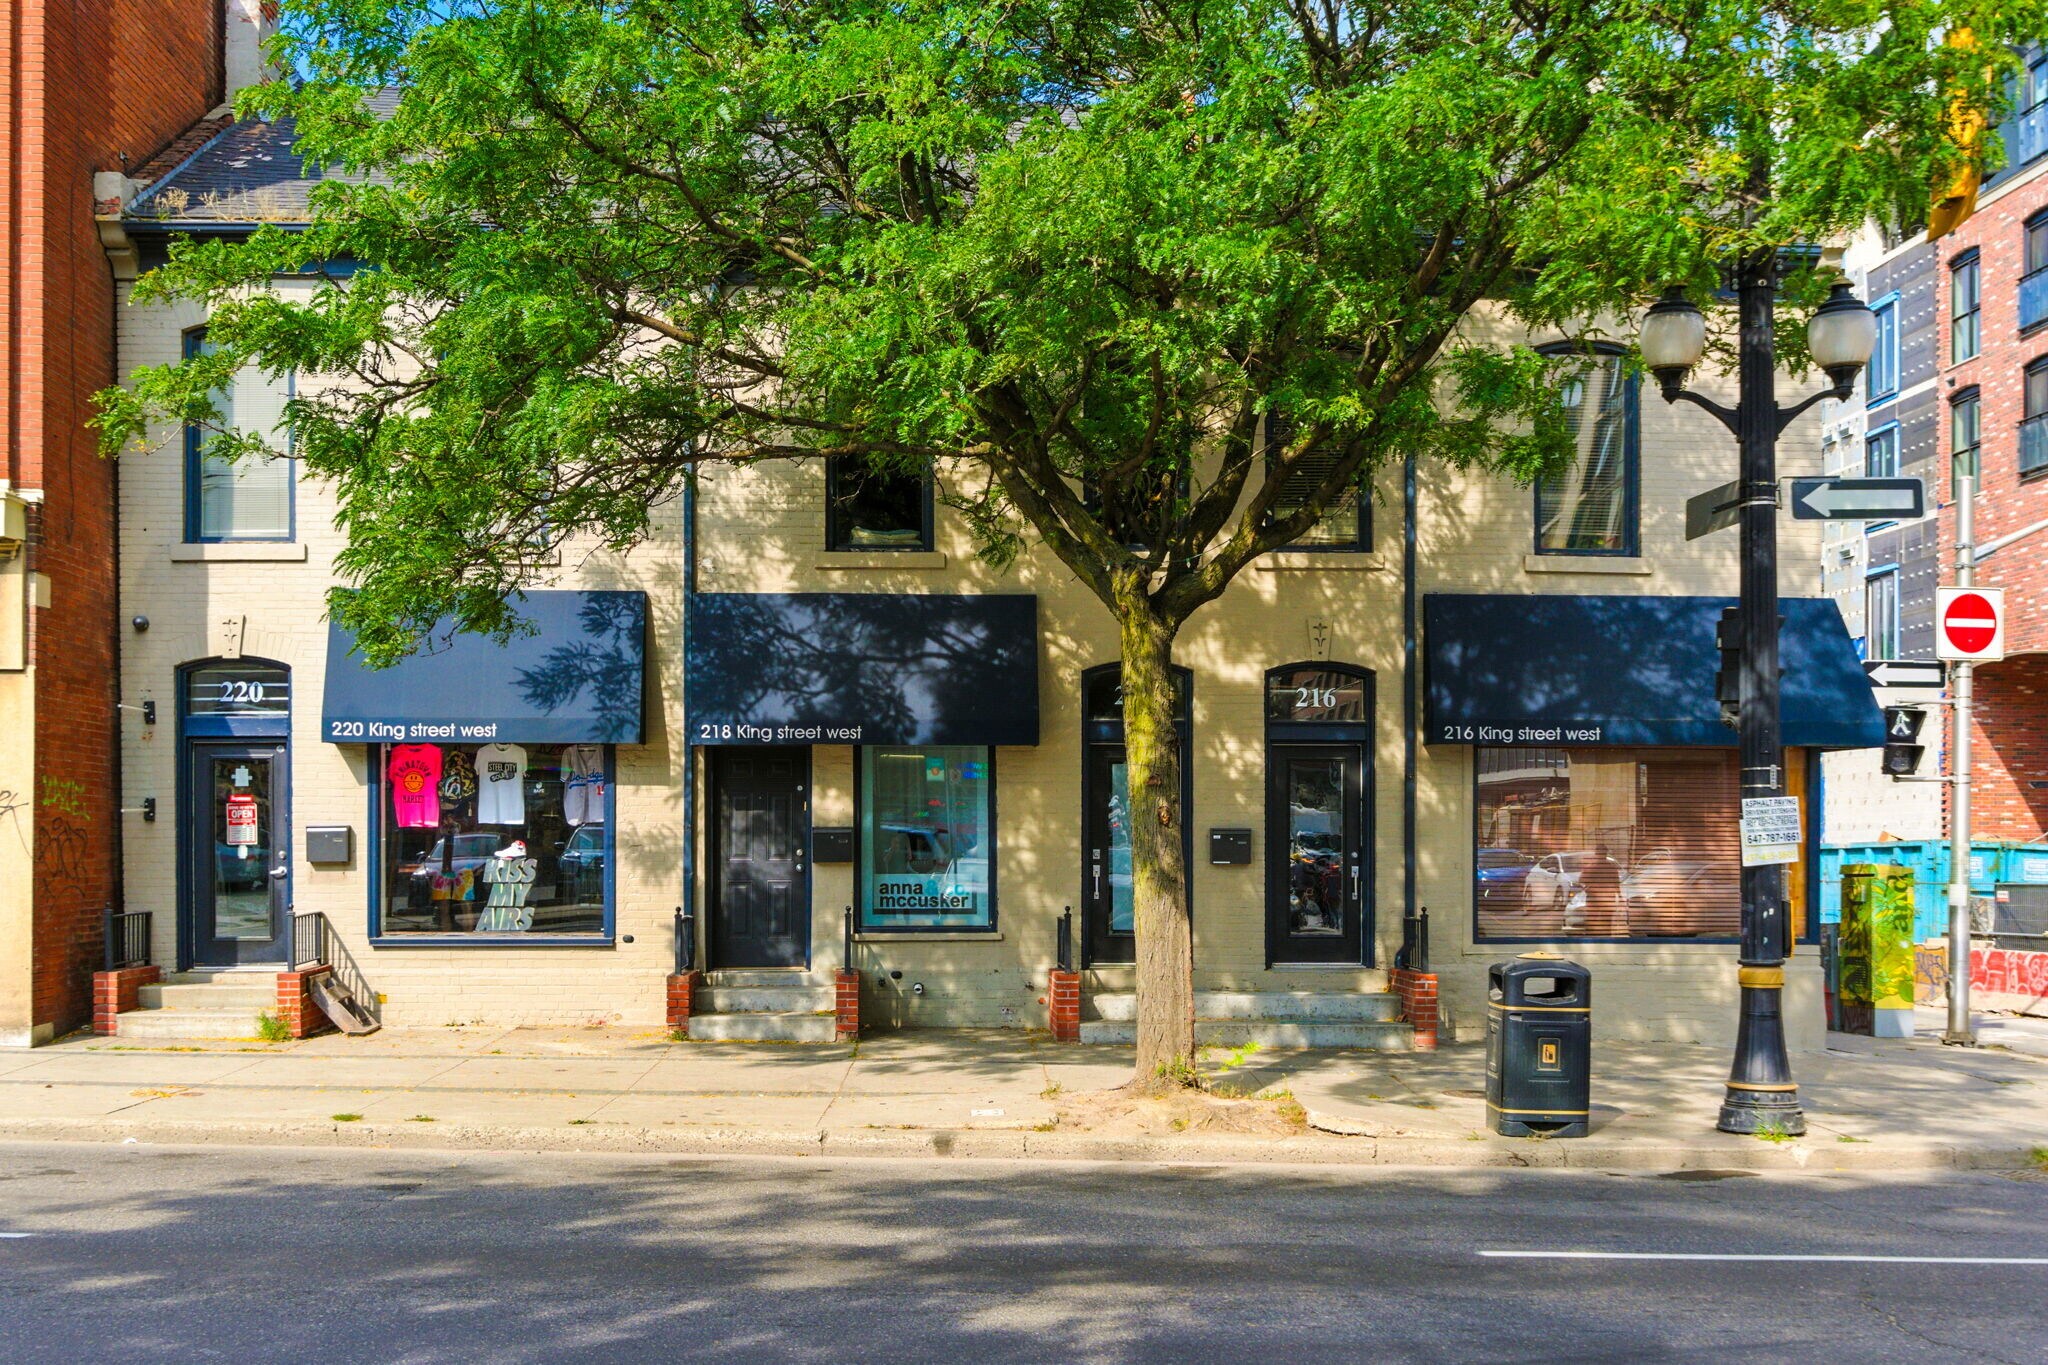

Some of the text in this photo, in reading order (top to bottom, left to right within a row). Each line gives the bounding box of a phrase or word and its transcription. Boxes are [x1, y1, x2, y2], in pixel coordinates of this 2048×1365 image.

[220, 681, 264, 703] 220
[1295, 687, 1336, 708] 216
[332, 722, 497, 740] 220 King street west
[701, 724, 862, 742] 218 King street west
[1444, 726, 1601, 743] 216 King street west
[488, 763, 517, 772] STEEL CITY
[1745, 798, 1796, 807] ASPHALT PAVING
[231, 809, 253, 818] OPEN
[482, 858, 538, 883] KISS
[487, 883, 533, 907] MY
[879, 882, 923, 895] anna
[925, 880, 939, 895] &
[880, 893, 968, 907] mccusker
[475, 907, 536, 932] AIRS
